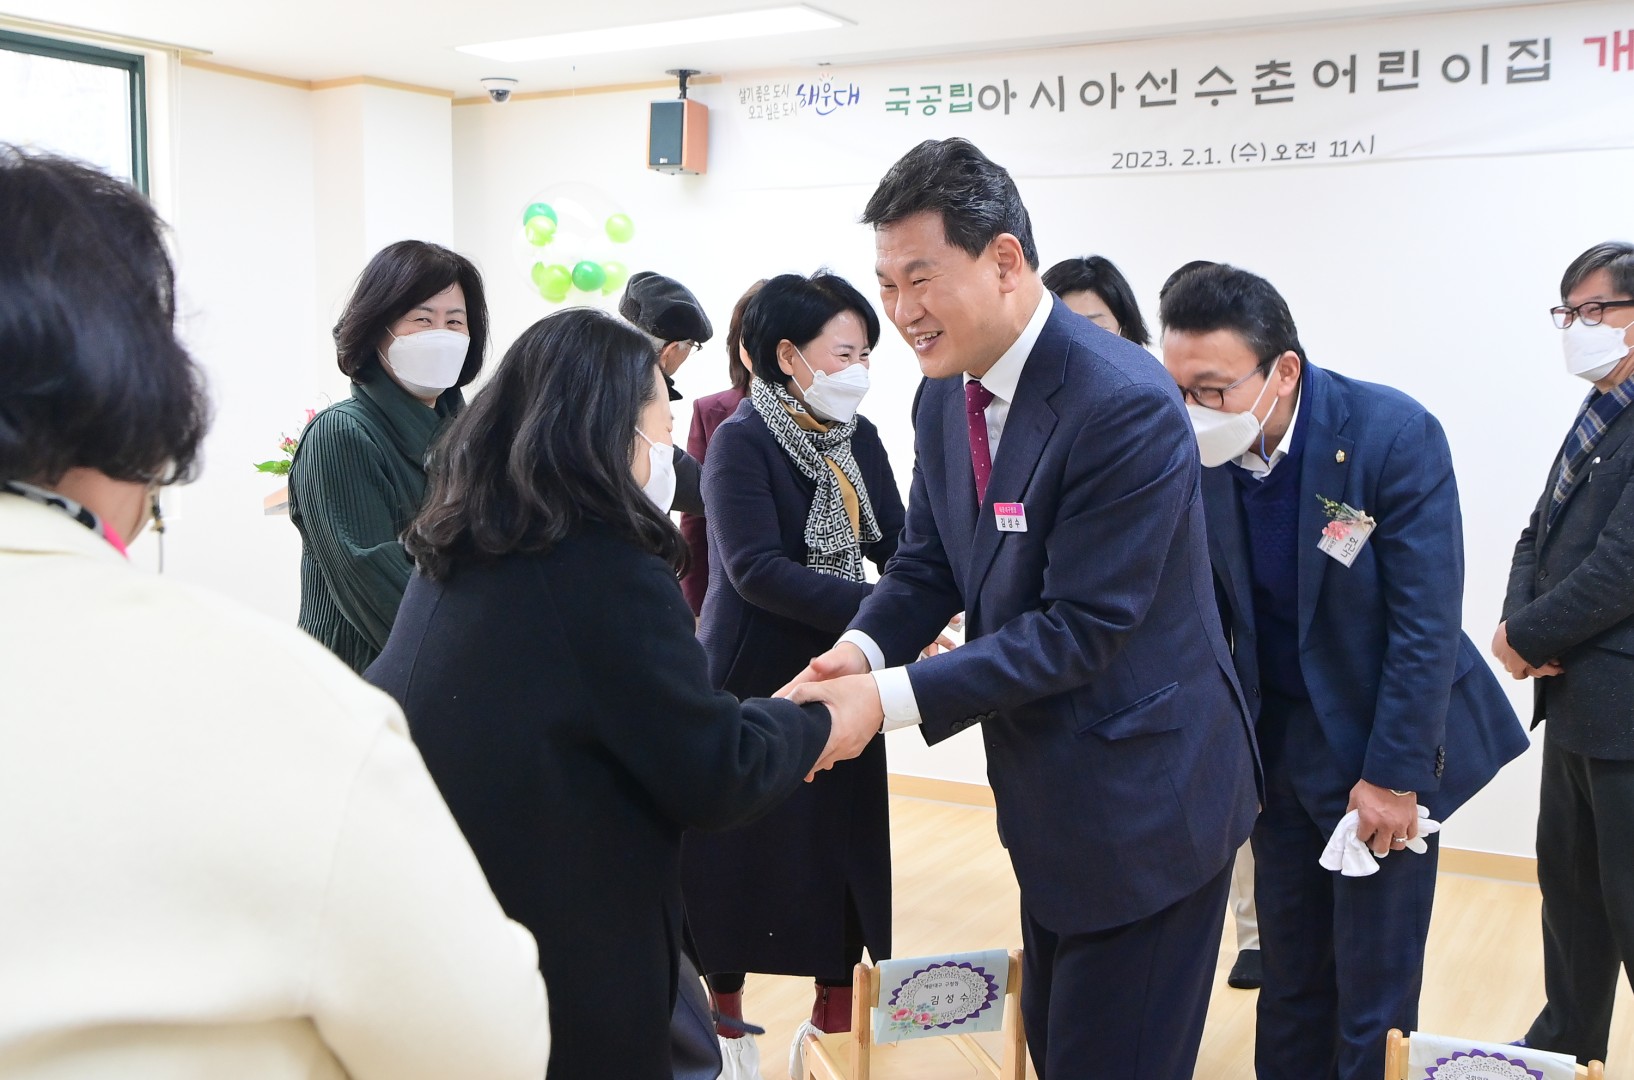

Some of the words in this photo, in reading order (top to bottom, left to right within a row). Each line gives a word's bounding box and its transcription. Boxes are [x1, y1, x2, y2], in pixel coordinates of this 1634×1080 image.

[885, 82, 973, 116] 국공립
[976, 37, 1552, 115] 아시아선수촌어린이집
[738, 87, 754, 104] 살기
[756, 84, 771, 102] 좋은
[772, 83, 790, 98] 도시
[795, 82, 861, 110] 해운대
[748, 104, 764, 119] 오고
[765, 103, 780, 120] 싶은
[782, 102, 798, 117] 도시
[1111, 151, 1173, 170] 2023.
[1182, 147, 1222, 167] 2.1.
[1328, 134, 1376, 159] 11시
[1340, 536, 1358, 557] 나근호
